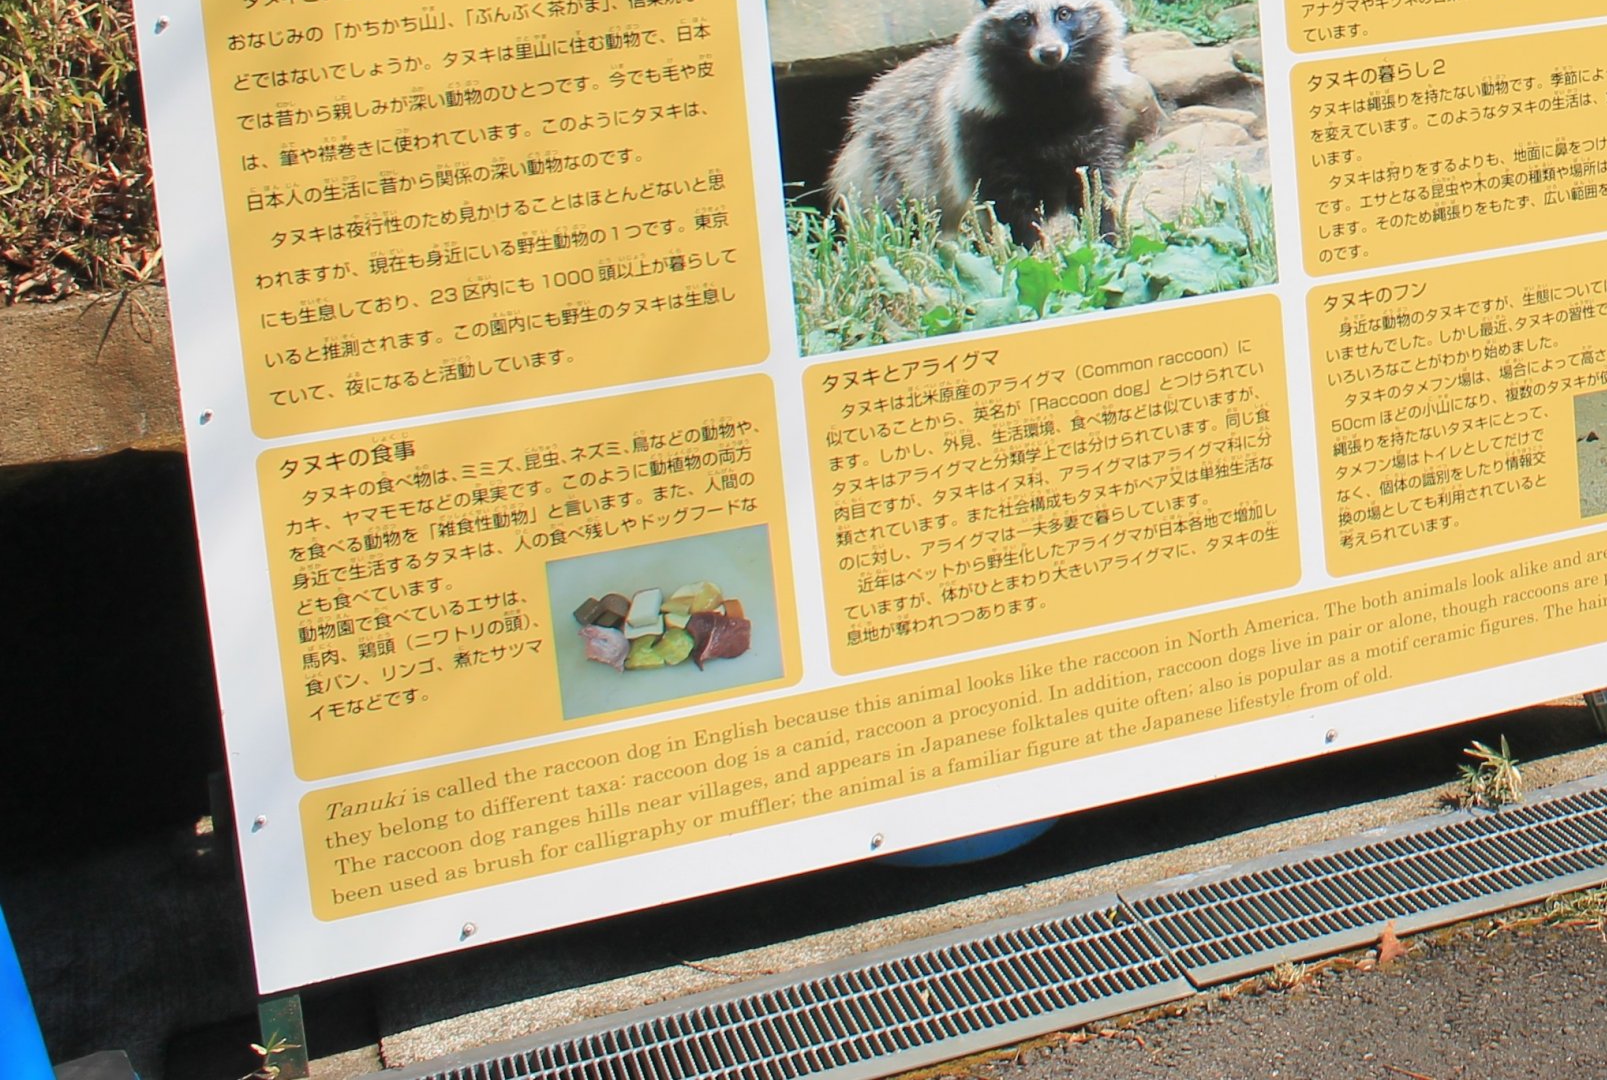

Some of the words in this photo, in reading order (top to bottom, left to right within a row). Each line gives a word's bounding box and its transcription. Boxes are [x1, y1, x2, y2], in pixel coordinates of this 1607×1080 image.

[1301, 21, 1369, 44] ています。
[1306, 57, 1447, 94] タヌキの暮らし2
[1322, 281, 1428, 315] タヌキのフン
[820, 348, 1001, 395] タヌキとアライグマ
[1331, 404, 1549, 459] 縄張りを持たないタヌキにとって、
[1334, 427, 1545, 482] タメフン場はトイレとしてだけで
[278, 438, 417, 481] タヌキの食事
[1335, 449, 1548, 504] なく、個体の識別をしたり情報交
[1336, 472, 1548, 529] 換の場としても利用されていると
[1339, 514, 1460, 550] 考えられています。
[295, 575, 454, 618] ども食べています。
[297, 588, 528, 646] 動物園で食べているエサは、
[301, 612, 540, 671] 馬肉、鶏頭（ニワトリの頭）、
[303, 638, 544, 699] 食パン、リンゴ、煮たサツマ
[308, 686, 430, 723] イモなどです。
[324, 828, 373, 851] they
[377, 812, 450, 839] belong
[480, 785, 571, 818] different
[575, 774, 627, 799] taxa:
[632, 760, 709, 788] raccoon
[713, 751, 749, 771] dog
[791, 727, 851, 755] canid,
[855, 716, 928, 742] raccoon
[948, 687, 1043, 726] procyonid.
[1073, 670, 1153, 697] addition,
[1157, 654, 1224, 680] raccoon
[1227, 645, 1267, 664] dogs
[1270, 637, 1303, 656] live
[1327, 622, 1363, 646] pair
[1388, 610, 1438, 630] alone,
[1440, 592, 1499, 619] though
[1502, 580, 1570, 606] raccoons
[1573, 574, 1600, 591] are
[325, 787, 408, 822] Tanuki
[435, 770, 499, 800] called
[502, 765, 538, 786] the
[542, 751, 621, 779] raccoon
[625, 742, 663, 761] dog
[693, 717, 769, 748] English
[772, 705, 850, 731] because
[853, 693, 892, 715] this
[896, 677, 963, 707] animal
[966, 669, 1016, 693] looks
[1018, 661, 1054, 682] like
[1057, 654, 1089, 674] the
[1093, 642, 1160, 667] raccoon
[1186, 622, 1240, 648] North
[1243, 609, 1320, 637] America.
[1323, 599, 1358, 619] The
[1360, 589, 1399, 611] both
[1402, 575, 1469, 603] animals
[1471, 566, 1506, 589] look
[1509, 559, 1549, 580] alike
[1552, 549, 1583, 571] and
[333, 855, 377, 877] The
[382, 838, 465, 867] raccoon
[469, 829, 507, 849] dog
[511, 814, 582, 841] ranges
[585, 800, 632, 825] hills
[636, 792, 683, 815] near
[686, 776, 769, 802] villages,
[773, 760, 811, 785] and
[815, 749, 892, 778] appears
[919, 725, 1008, 754] Japanese
[1011, 706, 1090, 736] folktales
[1093, 696, 1141, 719] quite
[1143, 683, 1194, 707] often;
[1198, 676, 1234, 696] also
[1256, 657, 1323, 685] popular
[1365, 634, 1410, 660] motif
[1411, 622, 1476, 650] ceramic
[1479, 612, 1540, 635] figures.
[1542, 602, 1575, 621] The
[329, 883, 384, 906] been
[388, 866, 440, 894] used
[472, 847, 535, 875] brush
[539, 842, 570, 862] for
[573, 817, 688, 854] calligraphy
[719, 792, 797, 824] muffler;
[801, 786, 834, 806] the
[838, 767, 905, 798] animal
[947, 747, 1023, 775] familiar
[1026, 735, 1081, 758] figure
[1107, 721, 1138, 740] the
[1141, 704, 1224, 733] Japanese
[1227, 686, 1296, 715] lifestyle
[1299, 679, 1340, 699] from
[1362, 663, 1394, 685] old.
